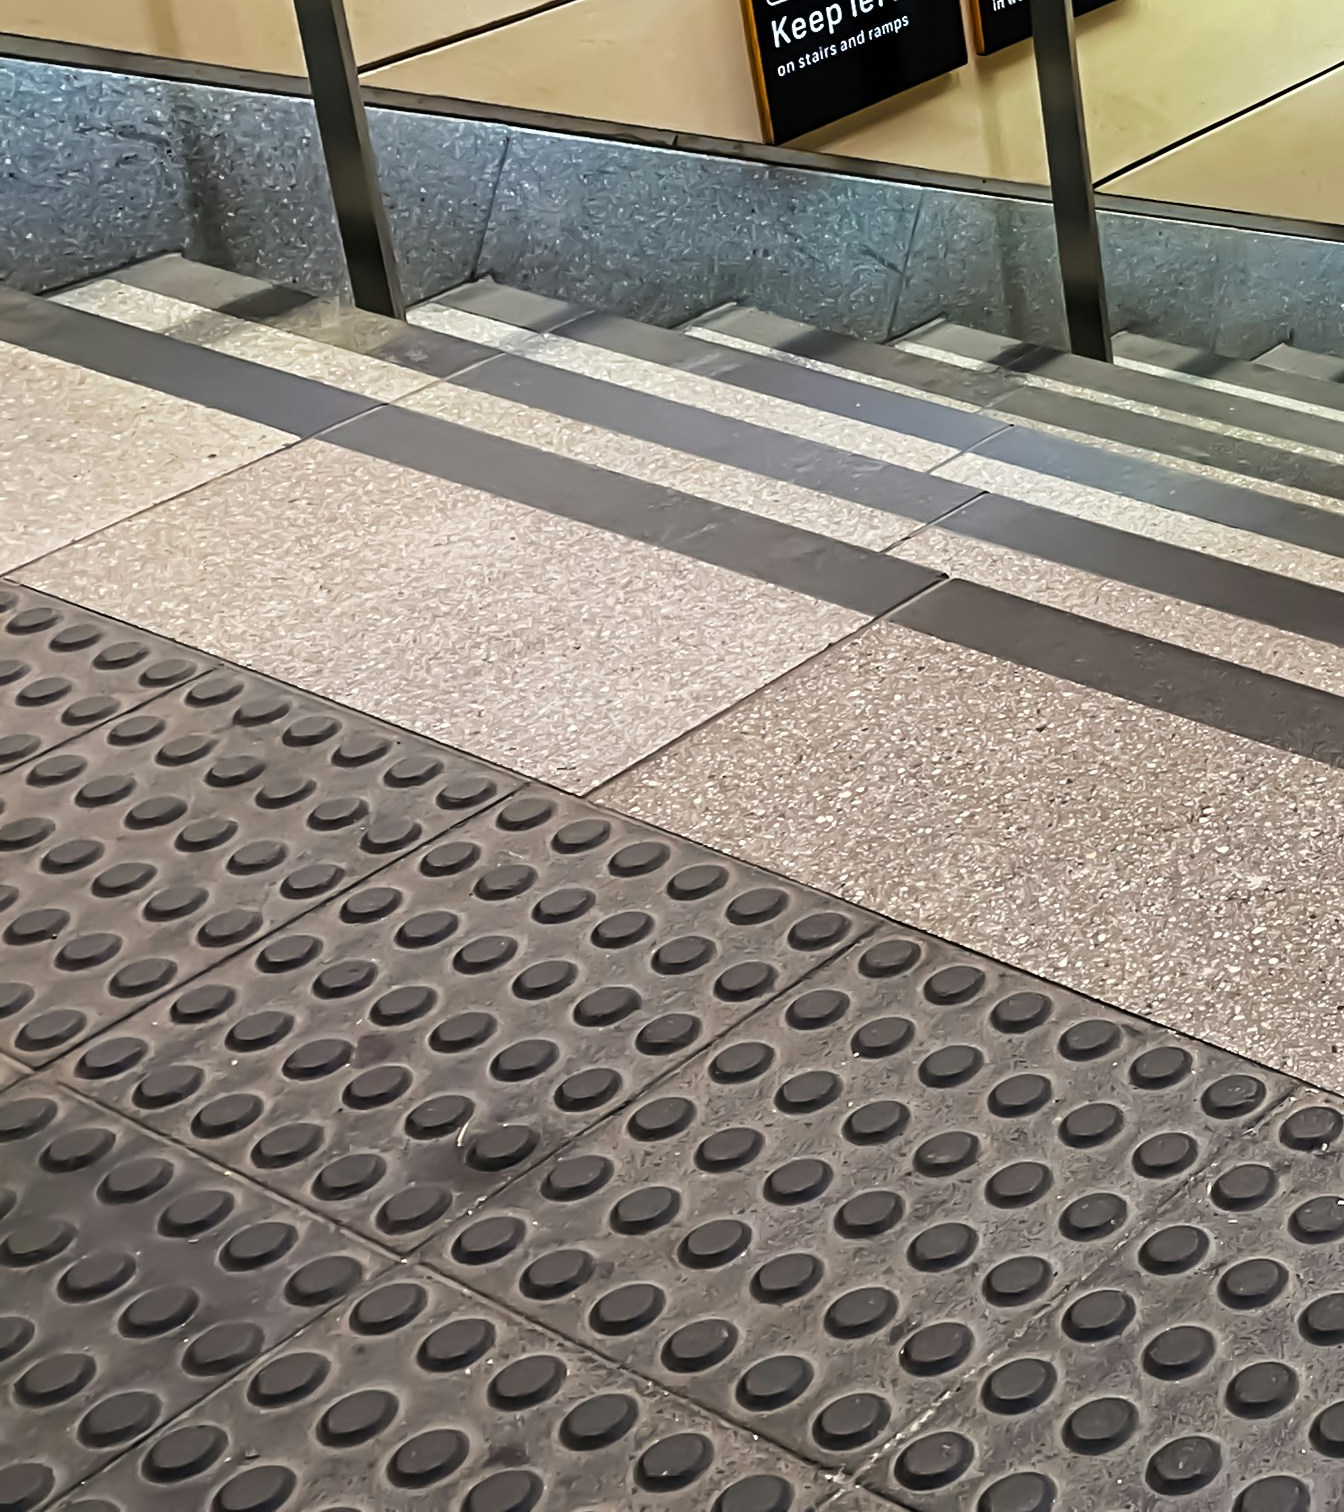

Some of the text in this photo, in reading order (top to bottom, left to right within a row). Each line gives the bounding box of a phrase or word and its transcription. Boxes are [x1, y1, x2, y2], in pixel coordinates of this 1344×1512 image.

[771, 3, 843, 48] Keep
[777, 15, 910, 77] on stairs and ramps
